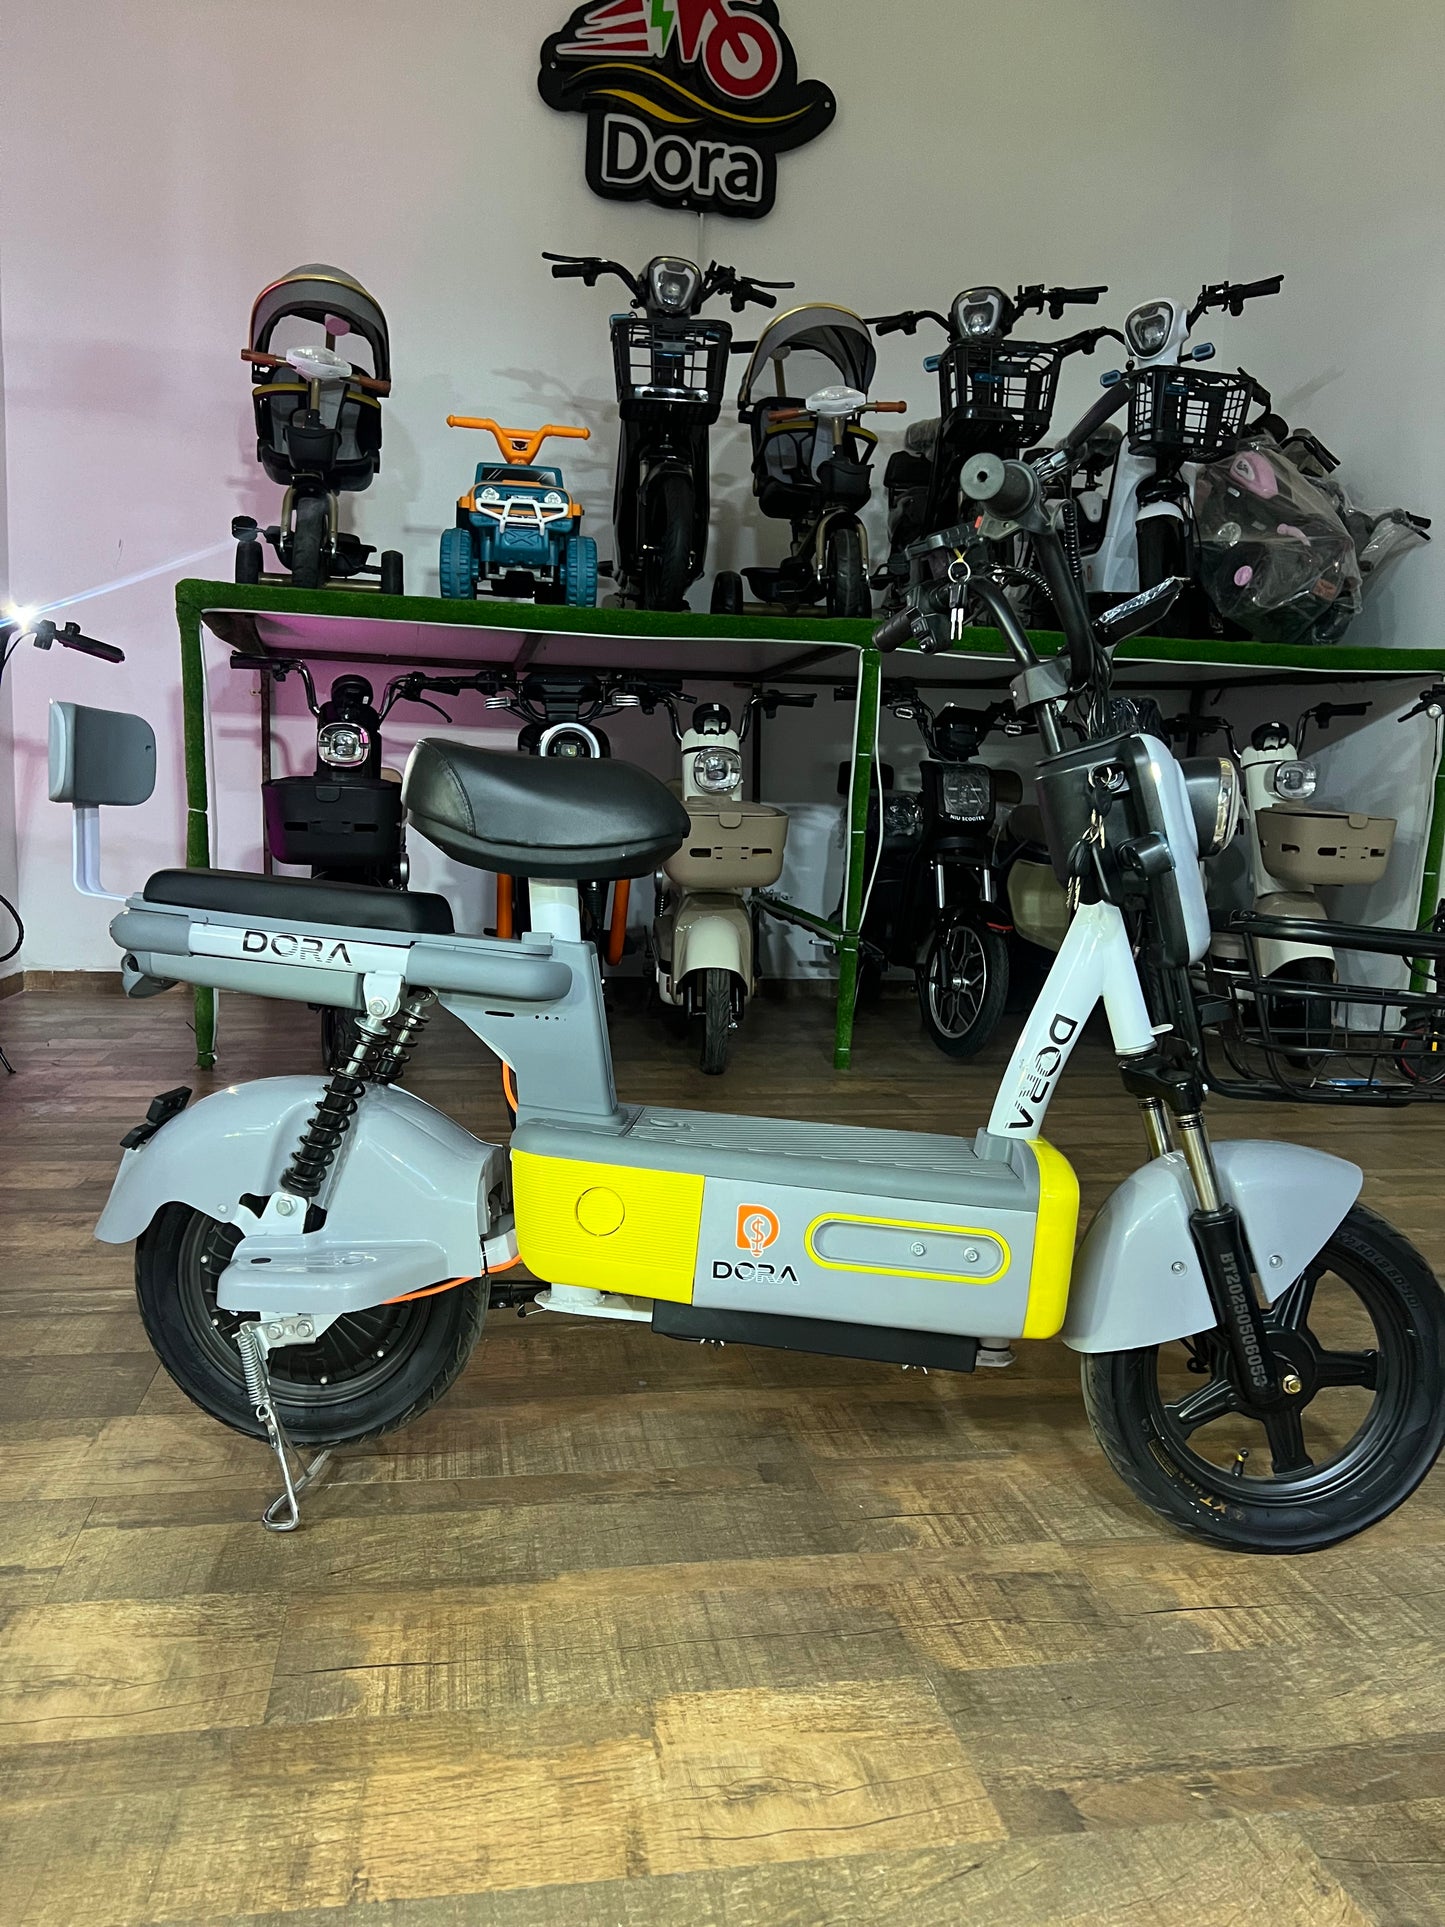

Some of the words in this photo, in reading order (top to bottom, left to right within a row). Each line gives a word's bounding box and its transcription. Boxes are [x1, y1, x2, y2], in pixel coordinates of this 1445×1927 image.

[603, 115, 761, 200] Dora
[243, 930, 353, 967] DORA
[1004, 1013, 1079, 1130] DORA
[712, 1260, 799, 1285] DORA
[1219, 1251, 1269, 1388] BT20250506053
